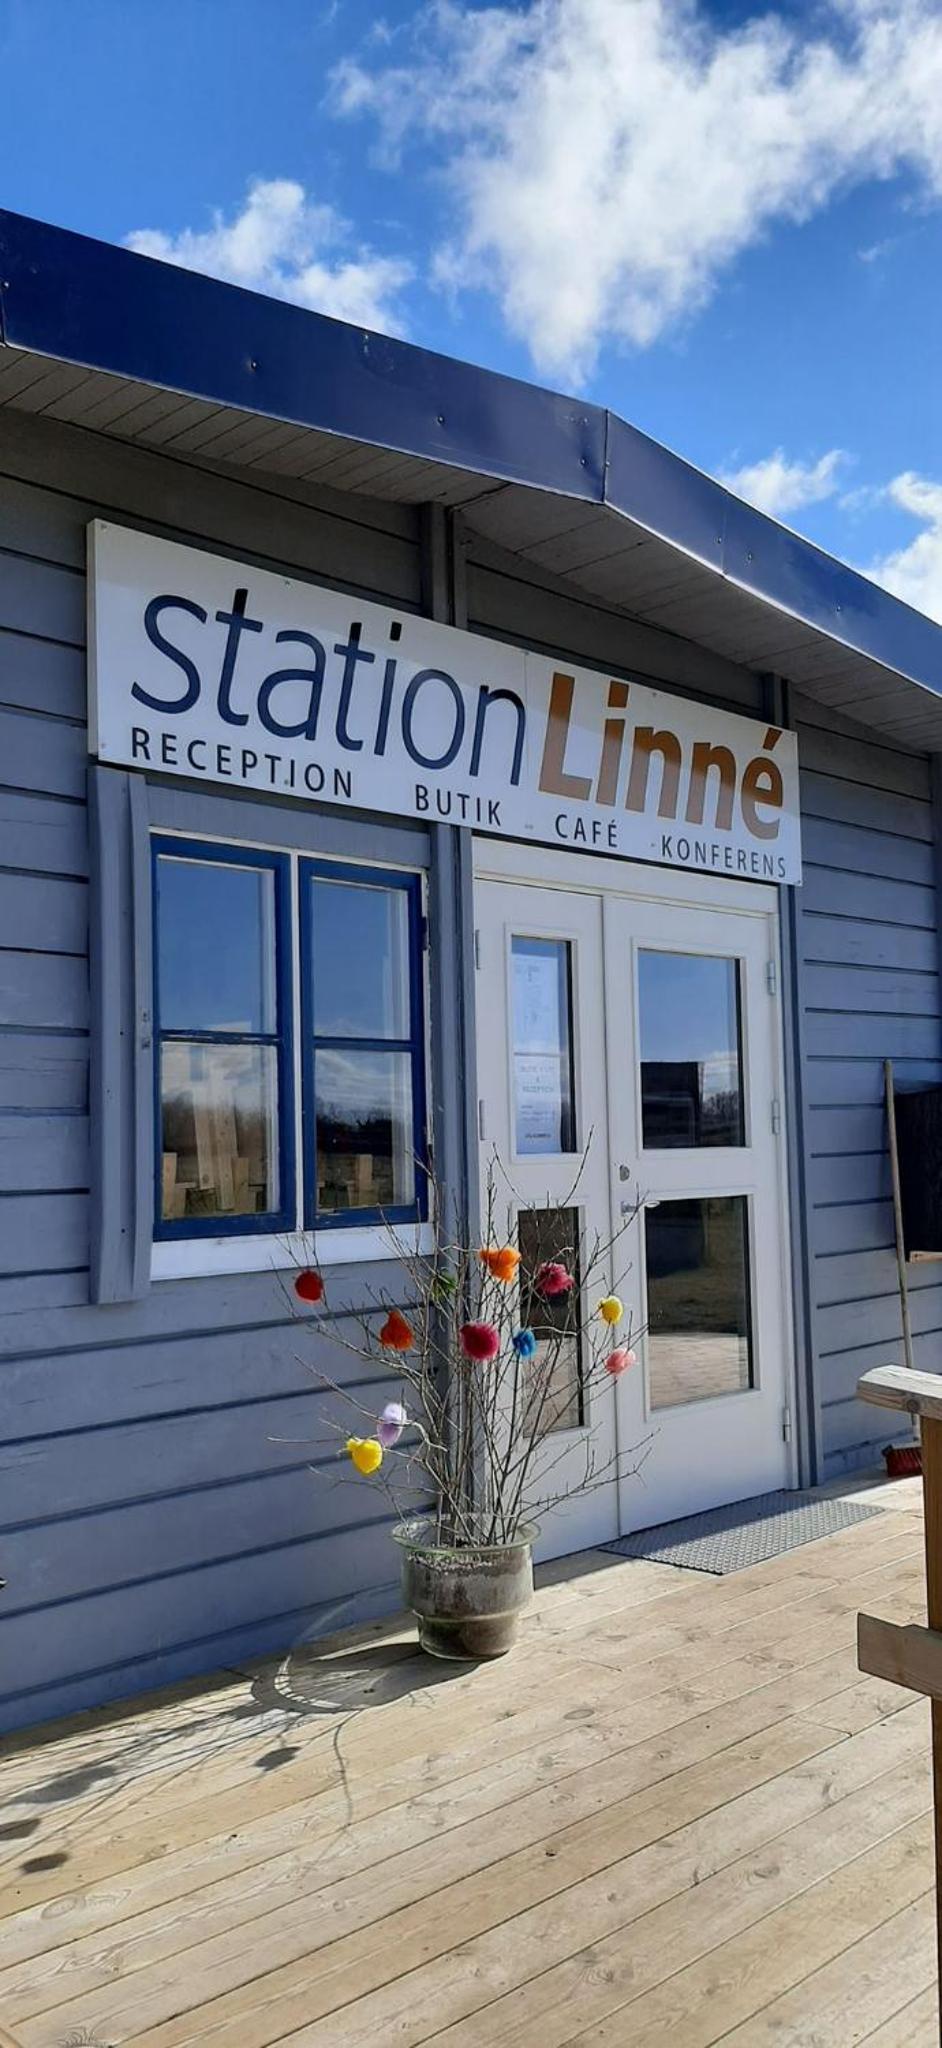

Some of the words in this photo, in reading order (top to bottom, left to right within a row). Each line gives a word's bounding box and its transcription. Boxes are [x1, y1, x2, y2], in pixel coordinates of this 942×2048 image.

[131, 727, 352, 798] RECEPTION
[415, 784, 501, 826] BUTIK
[555, 814, 619, 848] CAFÉ
[661, 834, 786, 878] KONFERENS
